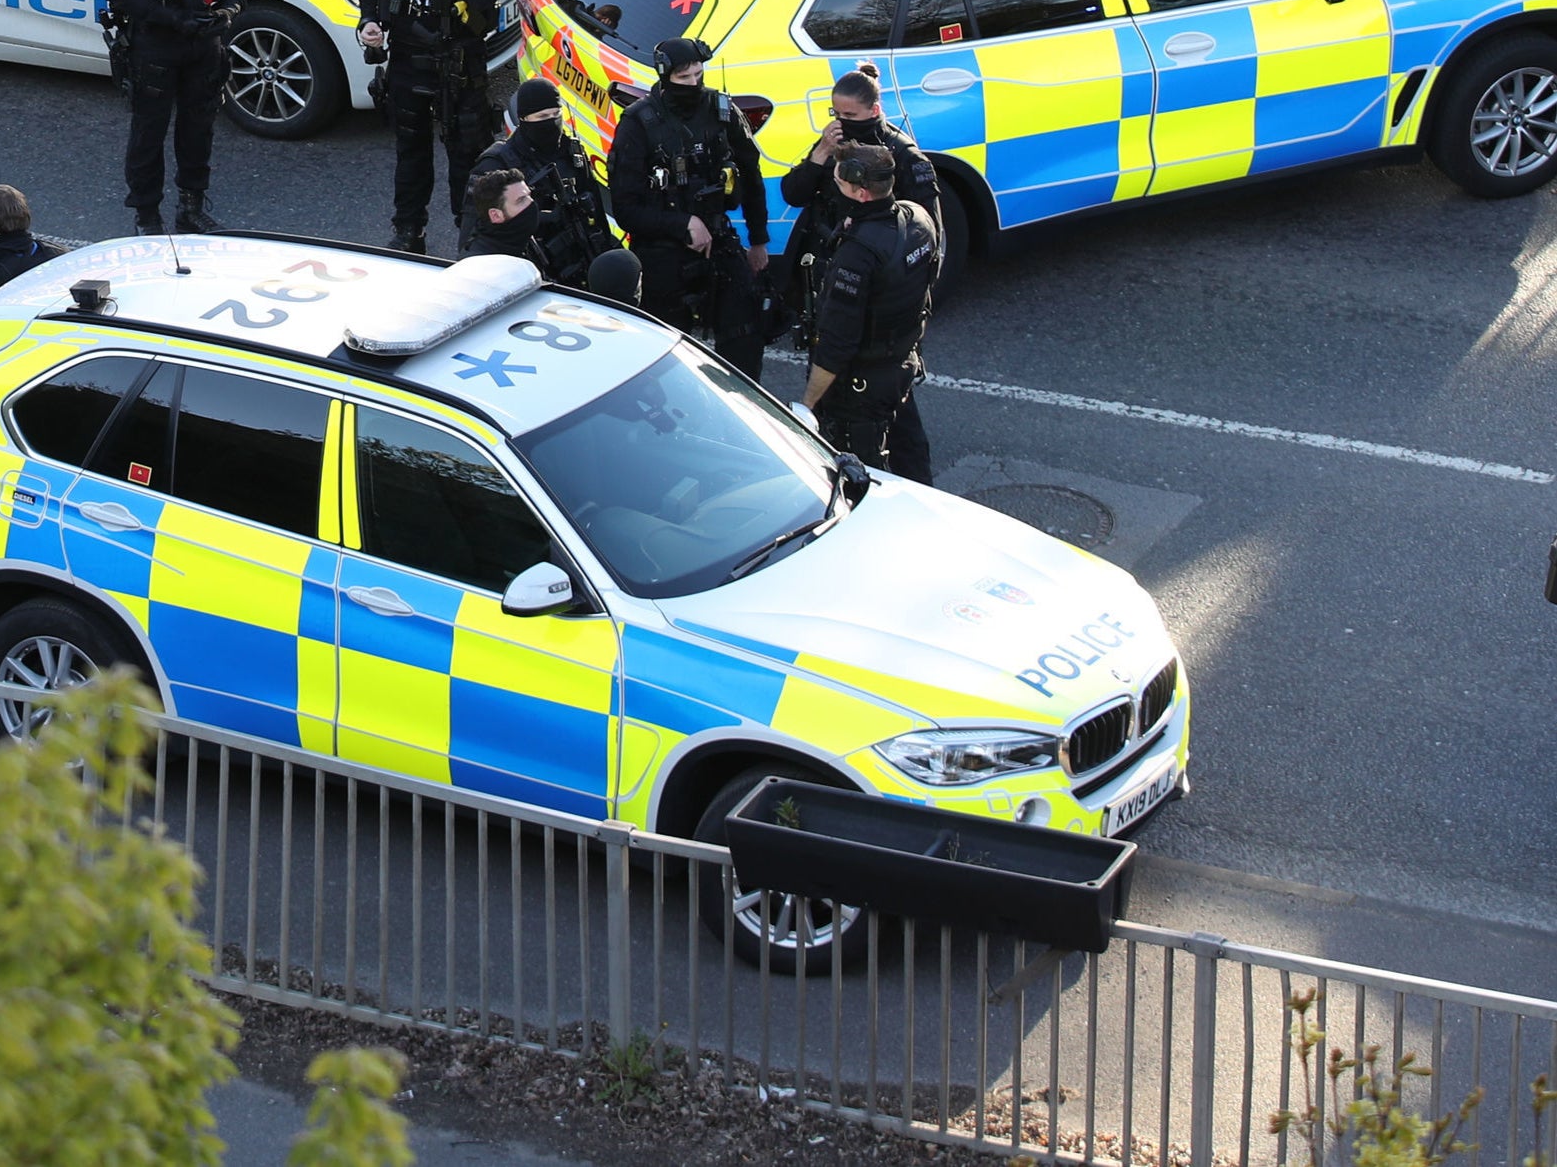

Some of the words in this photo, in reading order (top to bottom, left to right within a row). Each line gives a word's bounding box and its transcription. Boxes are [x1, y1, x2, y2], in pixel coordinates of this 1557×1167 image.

[555, 55, 584, 91] LG70
[585, 76, 607, 110] PWV
[199, 259, 369, 330] 292
[14, 492, 34, 504] DIESEL
[1015, 612, 1136, 699] POLICE
[1115, 790, 1146, 828] KX19
